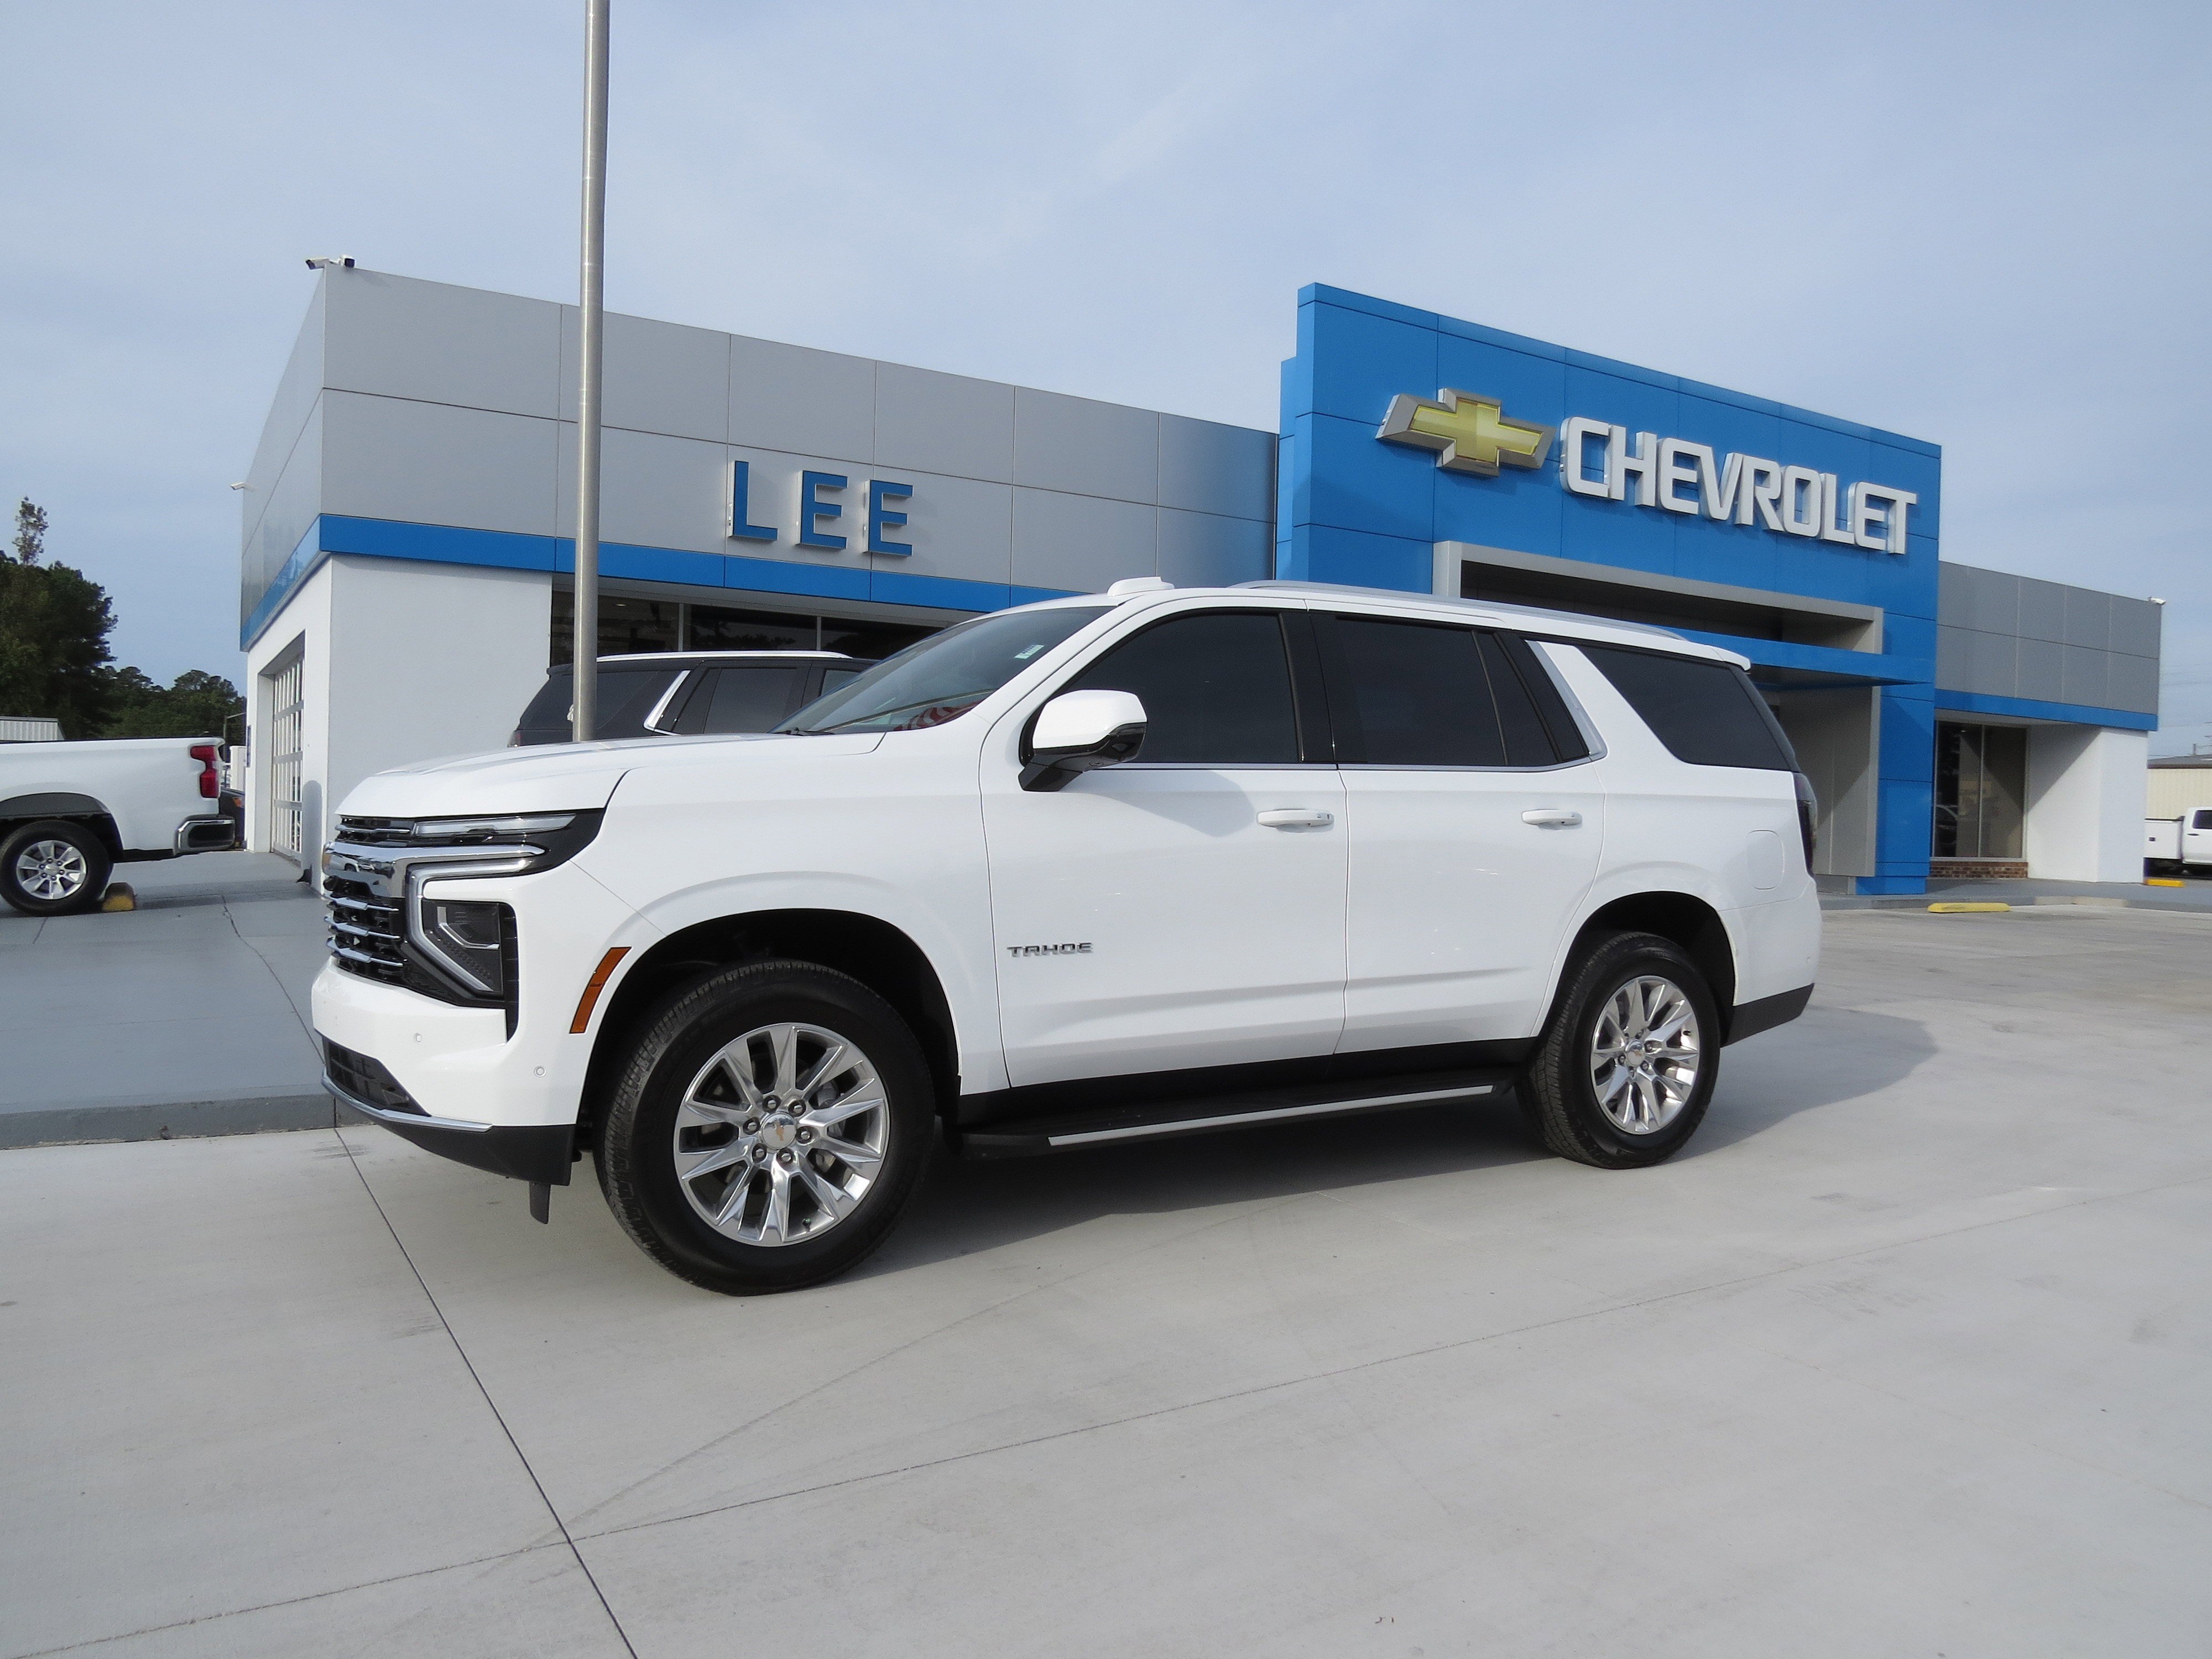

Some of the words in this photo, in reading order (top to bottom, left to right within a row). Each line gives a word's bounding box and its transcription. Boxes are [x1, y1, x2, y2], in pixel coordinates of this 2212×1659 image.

[729, 461, 914, 556] LEE
[1559, 416, 1917, 555] CHEVROLET
[1006, 942, 1092, 957] TAHOE
